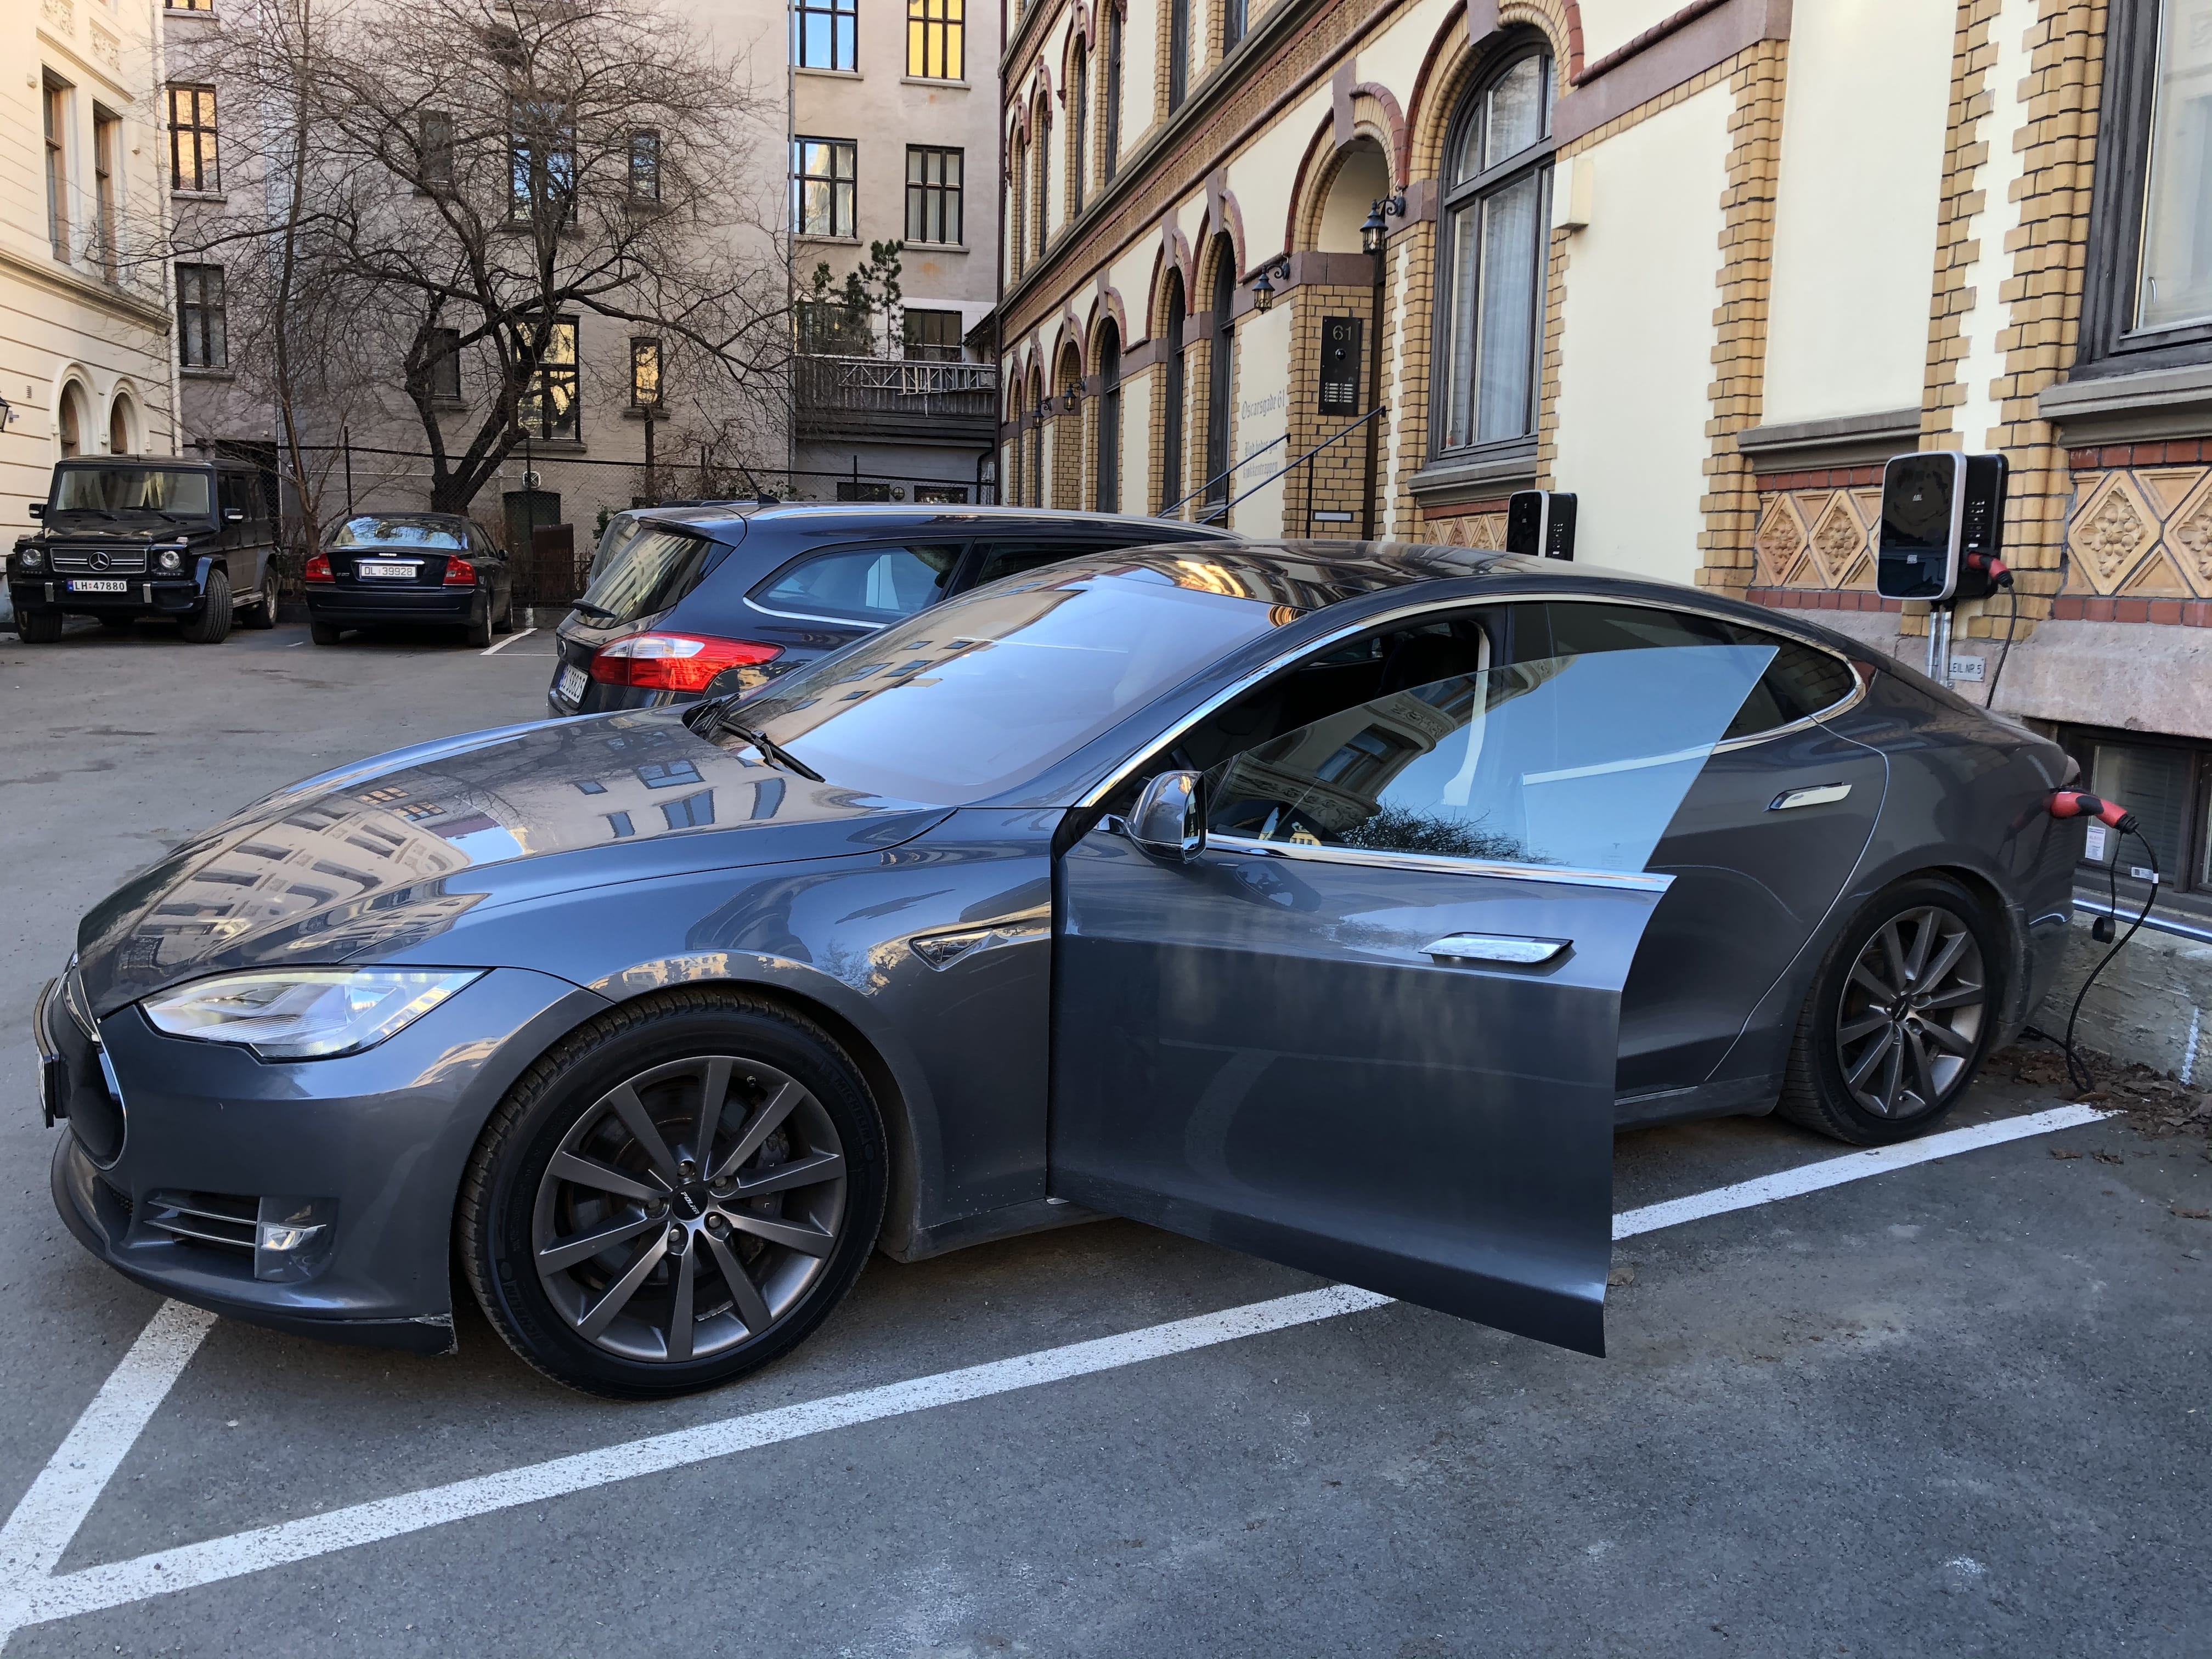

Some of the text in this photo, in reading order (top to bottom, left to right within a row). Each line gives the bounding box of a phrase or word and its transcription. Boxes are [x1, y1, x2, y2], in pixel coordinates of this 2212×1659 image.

[1333, 325, 1352, 341] 61
[75, 582, 125, 590] LH 47880
[833, 1075, 870, 1137] MICHELIN
